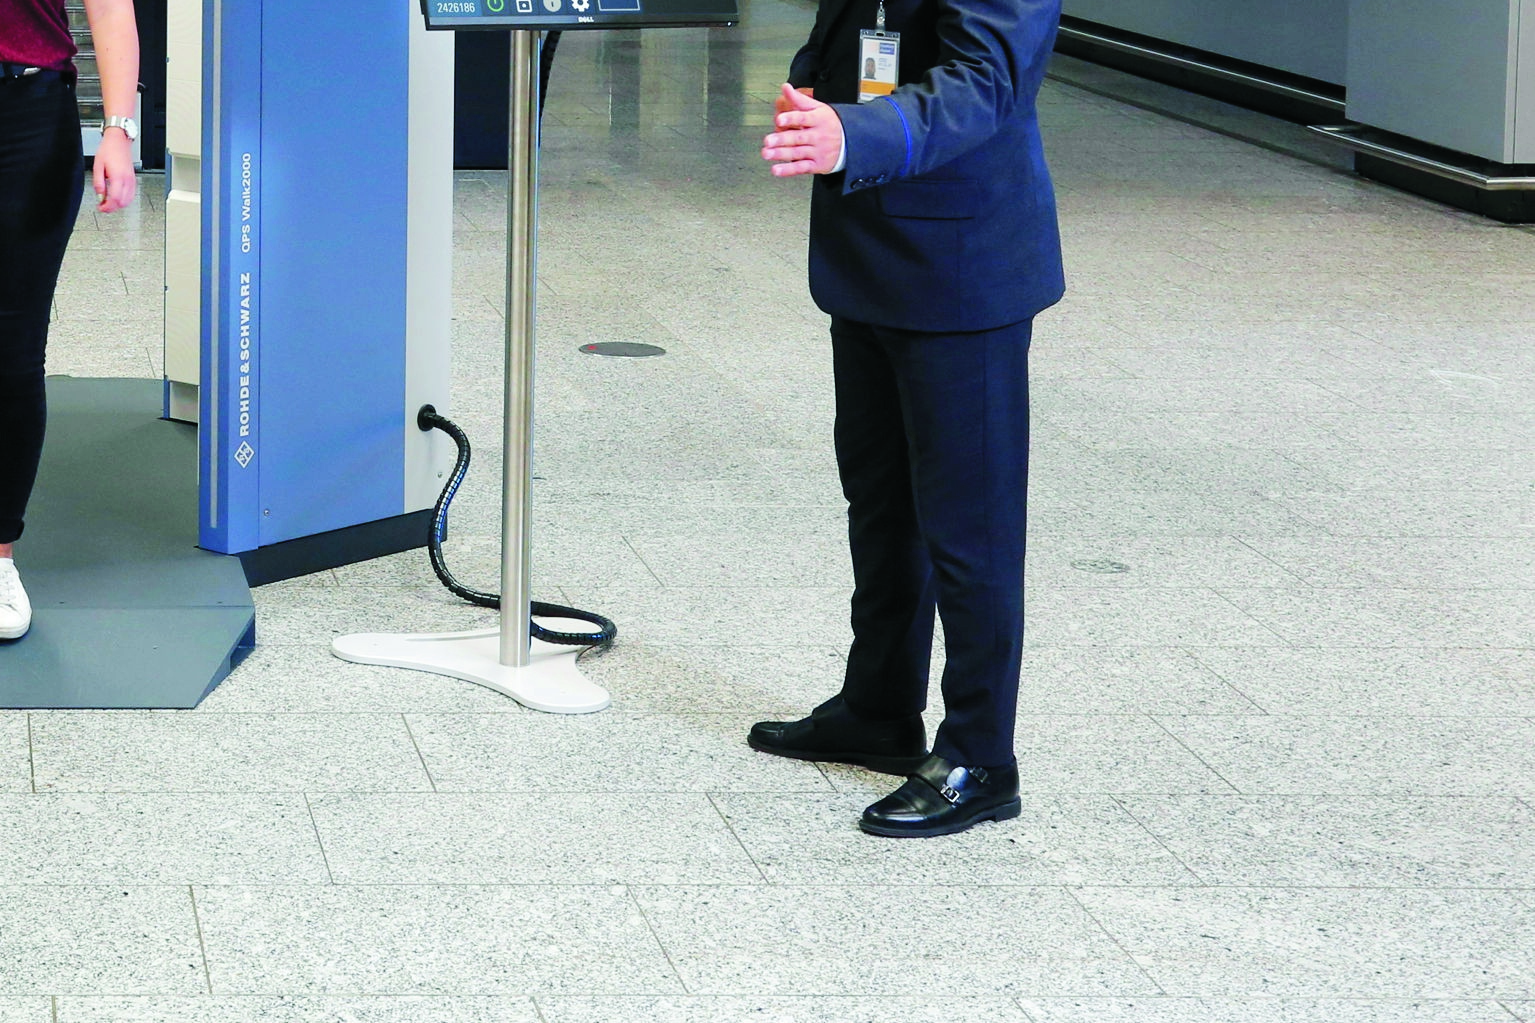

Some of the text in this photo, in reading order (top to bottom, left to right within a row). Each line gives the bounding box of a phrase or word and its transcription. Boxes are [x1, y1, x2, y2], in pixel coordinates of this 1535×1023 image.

[437, 2, 476, 13] 2426186
[241, 152, 252, 220] Walk2000
[241, 224, 251, 254] QPS
[239, 272, 251, 437] ROHDE&SCHWARZ
